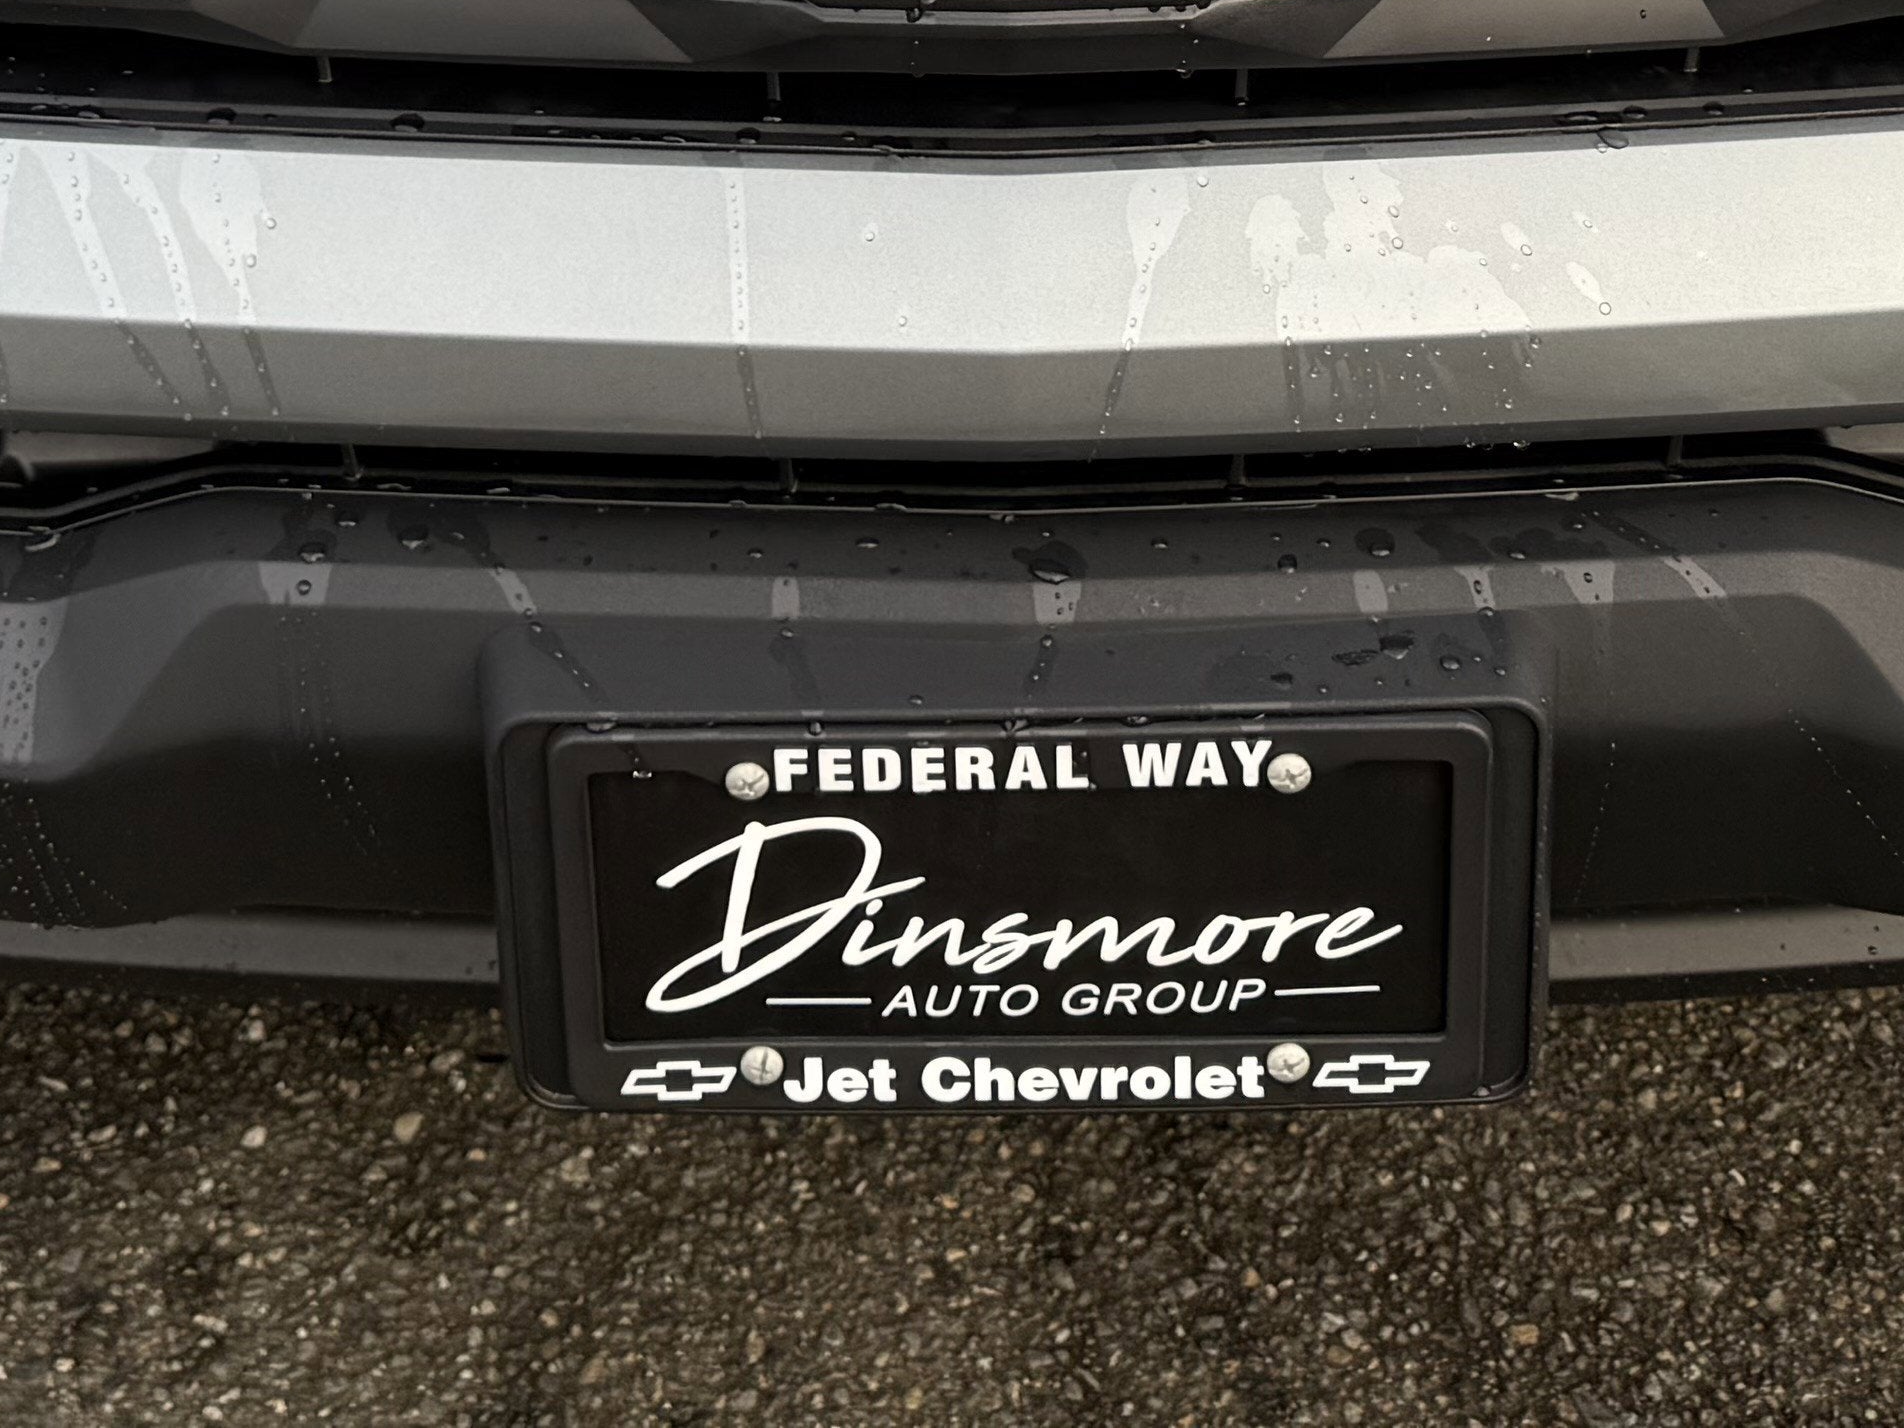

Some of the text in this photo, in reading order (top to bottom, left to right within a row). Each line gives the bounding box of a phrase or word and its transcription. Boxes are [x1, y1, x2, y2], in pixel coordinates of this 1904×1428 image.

[773, 739, 1273, 794] FEDERAL WAY
[645, 816, 1403, 1013] Dinsmore
[881, 978, 1267, 1019] AUTO GROUP
[783, 1055, 1266, 1103] Jet Chevrolet
